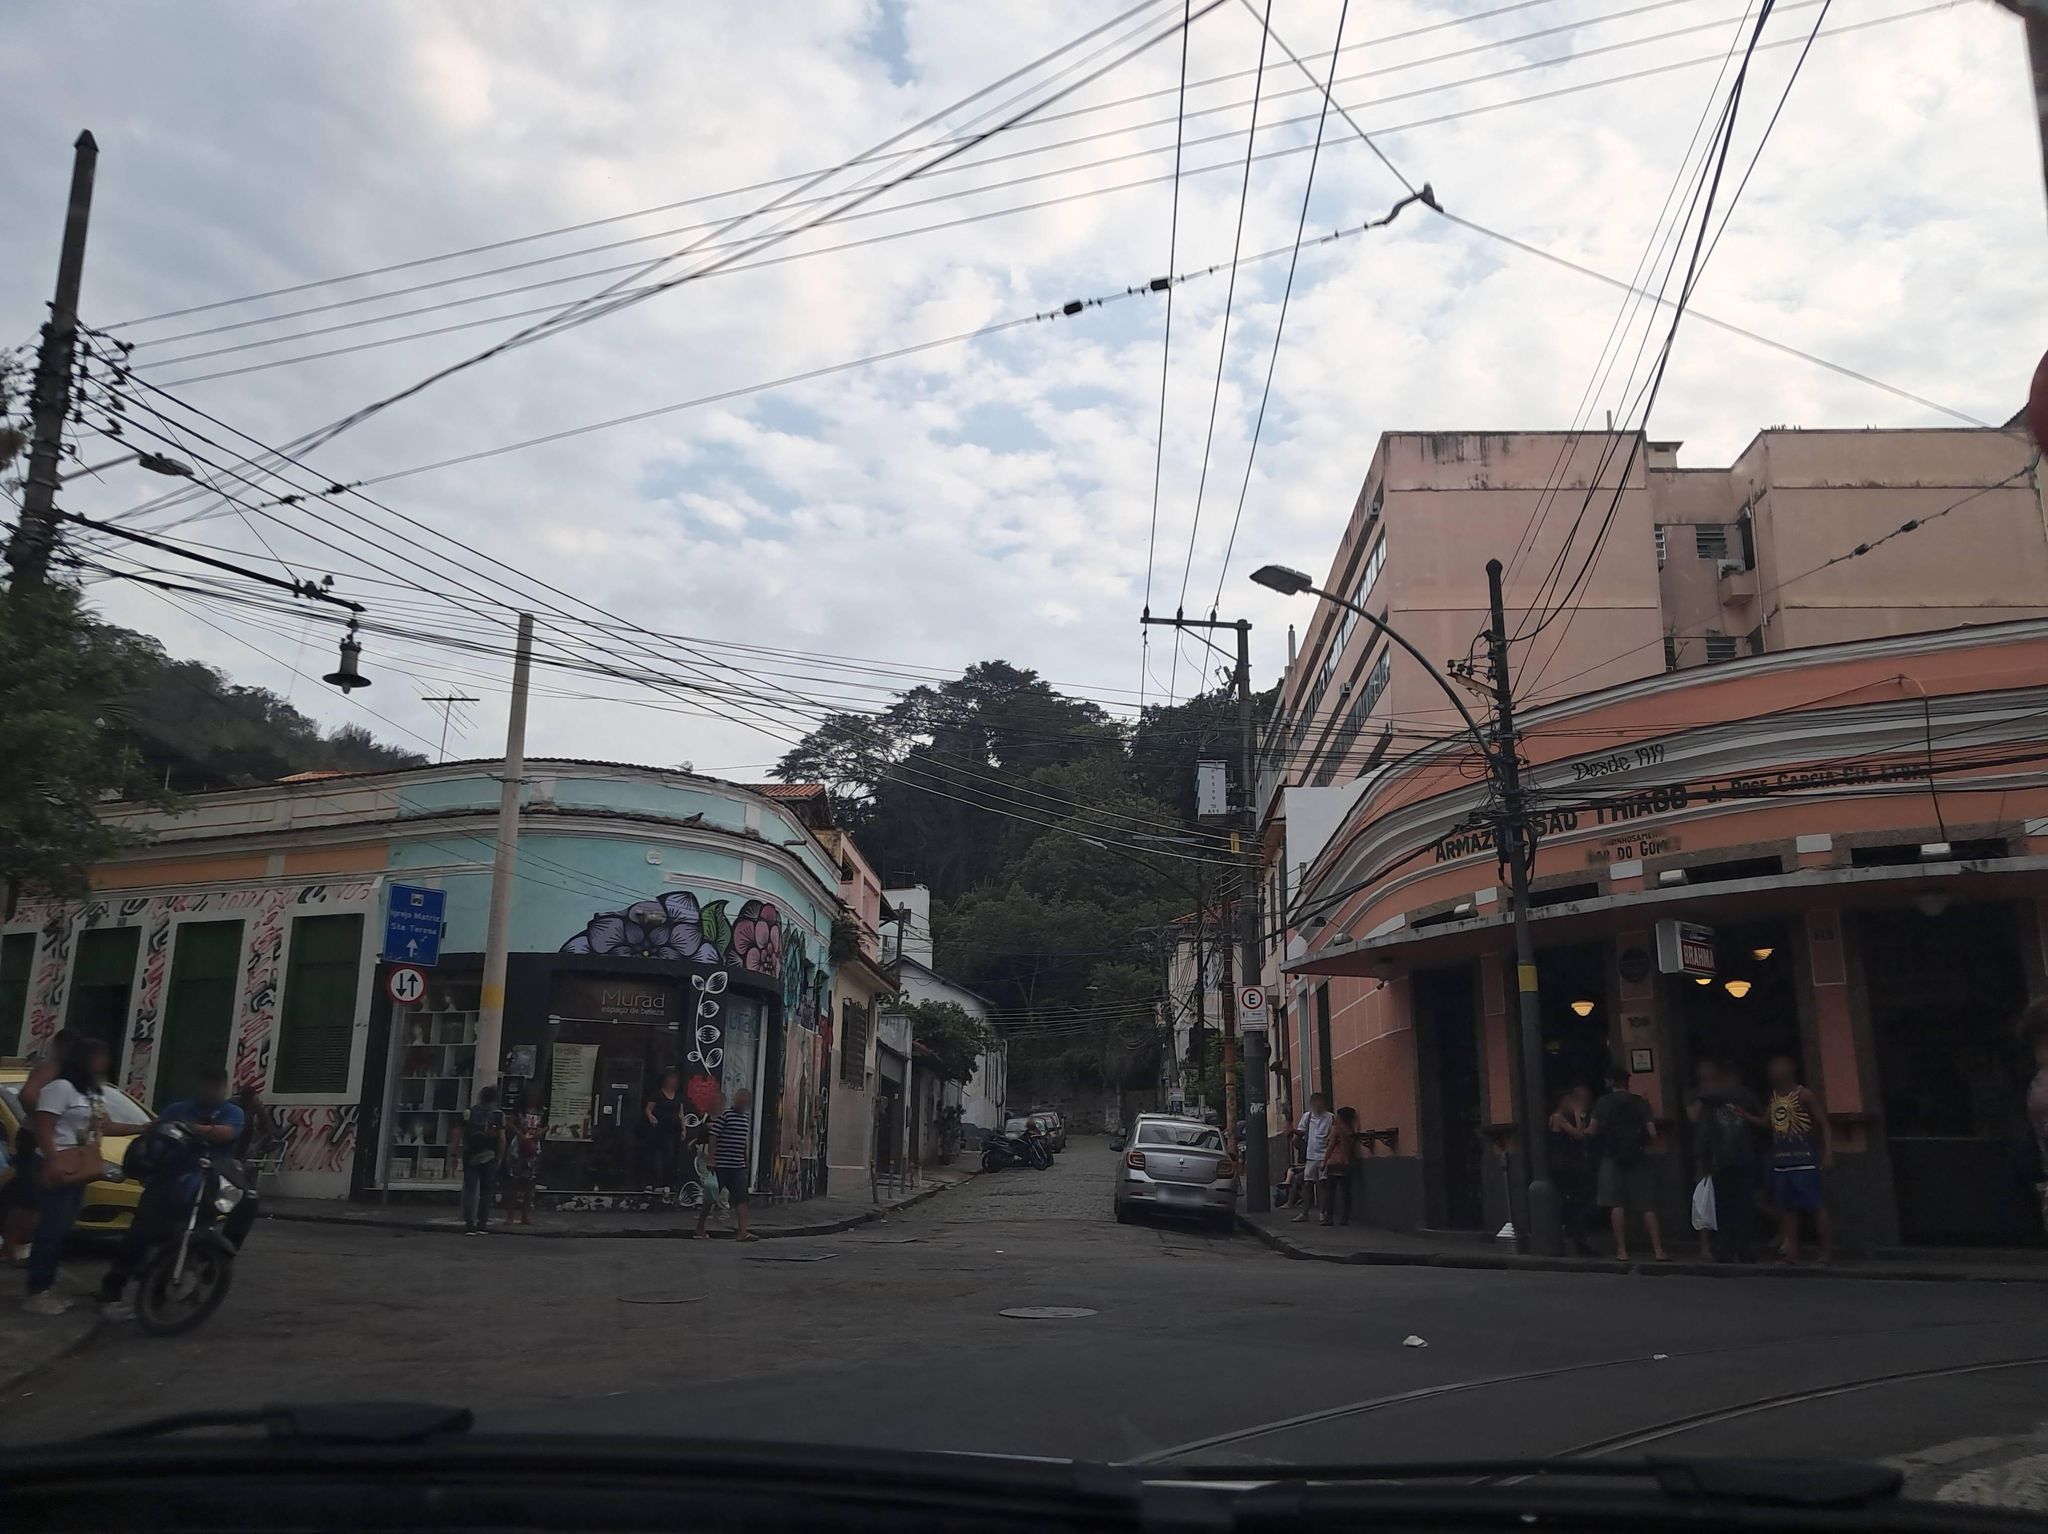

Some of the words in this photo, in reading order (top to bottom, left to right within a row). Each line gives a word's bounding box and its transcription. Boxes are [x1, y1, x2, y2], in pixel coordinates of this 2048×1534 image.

[1571, 754, 1631, 781] Desde
[1635, 744, 1665, 766] 1919
[1618, 846, 1632, 860] DO
[414, 912, 441, 923] Matriz
[1683, 945, 1716, 969] BRAHMA
[602, 988, 665, 1008] Murad
[1248, 993, 1256, 1005] E
